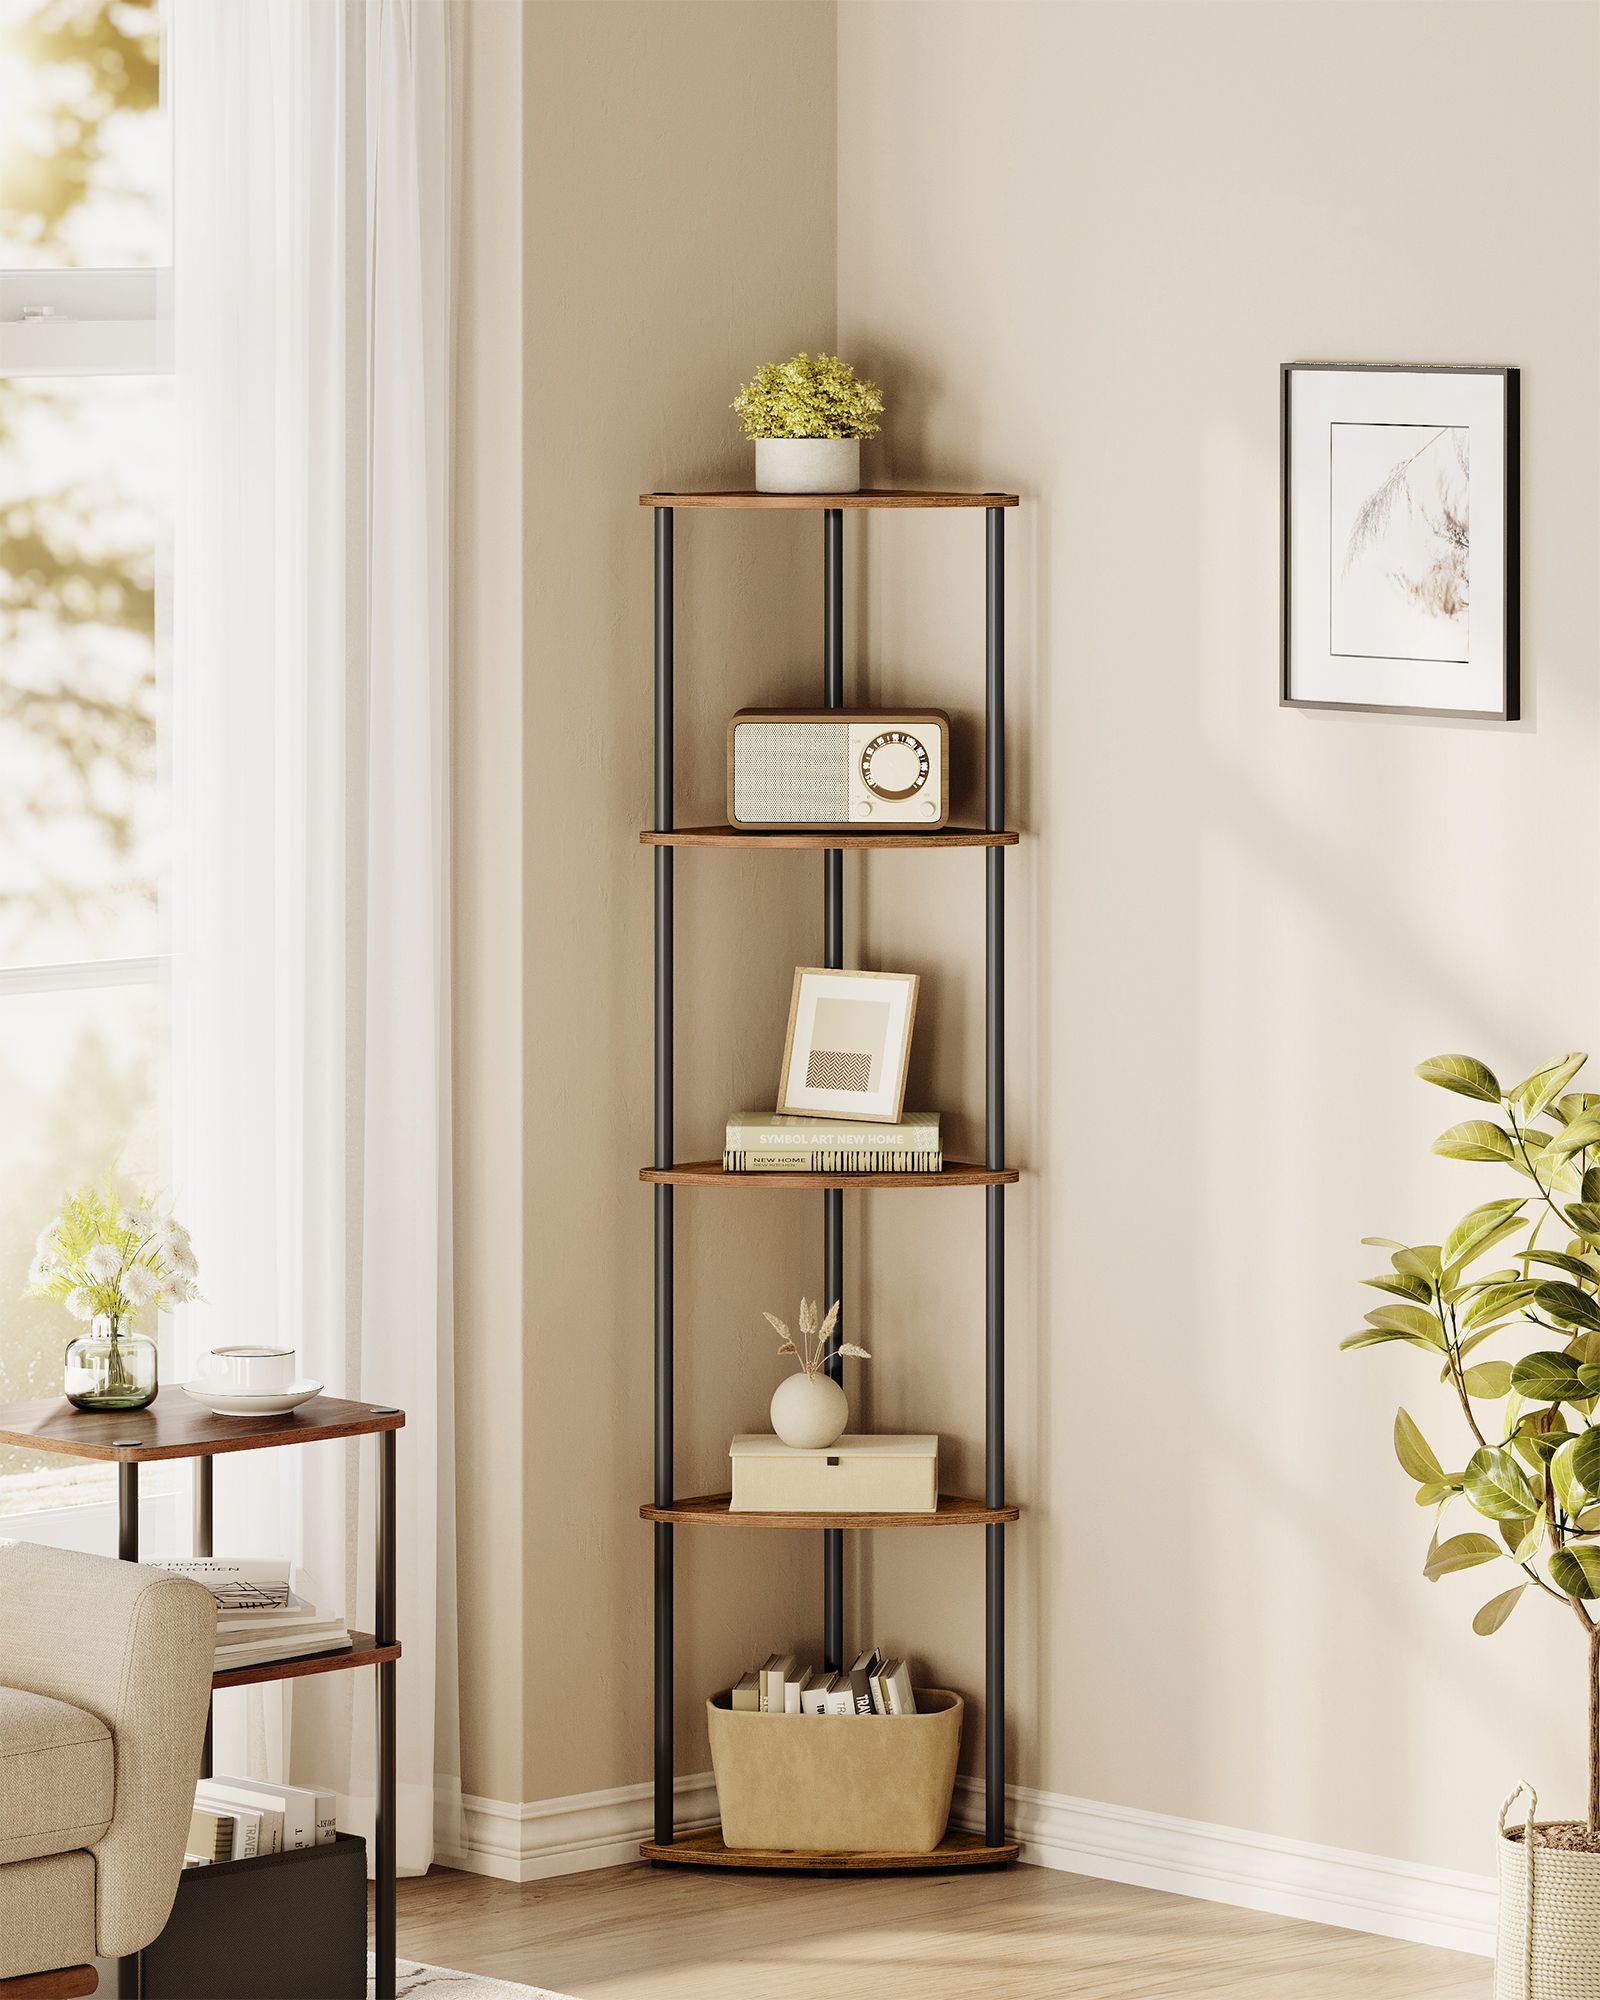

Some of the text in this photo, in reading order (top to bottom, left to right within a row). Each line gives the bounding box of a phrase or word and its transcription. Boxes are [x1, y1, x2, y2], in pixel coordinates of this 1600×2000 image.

[759, 1134, 904, 1145] SYMBOL ART NEW HOME
[837, 1701, 847, 1715] TR
[244, 1823, 257, 1858] TRAVEL
